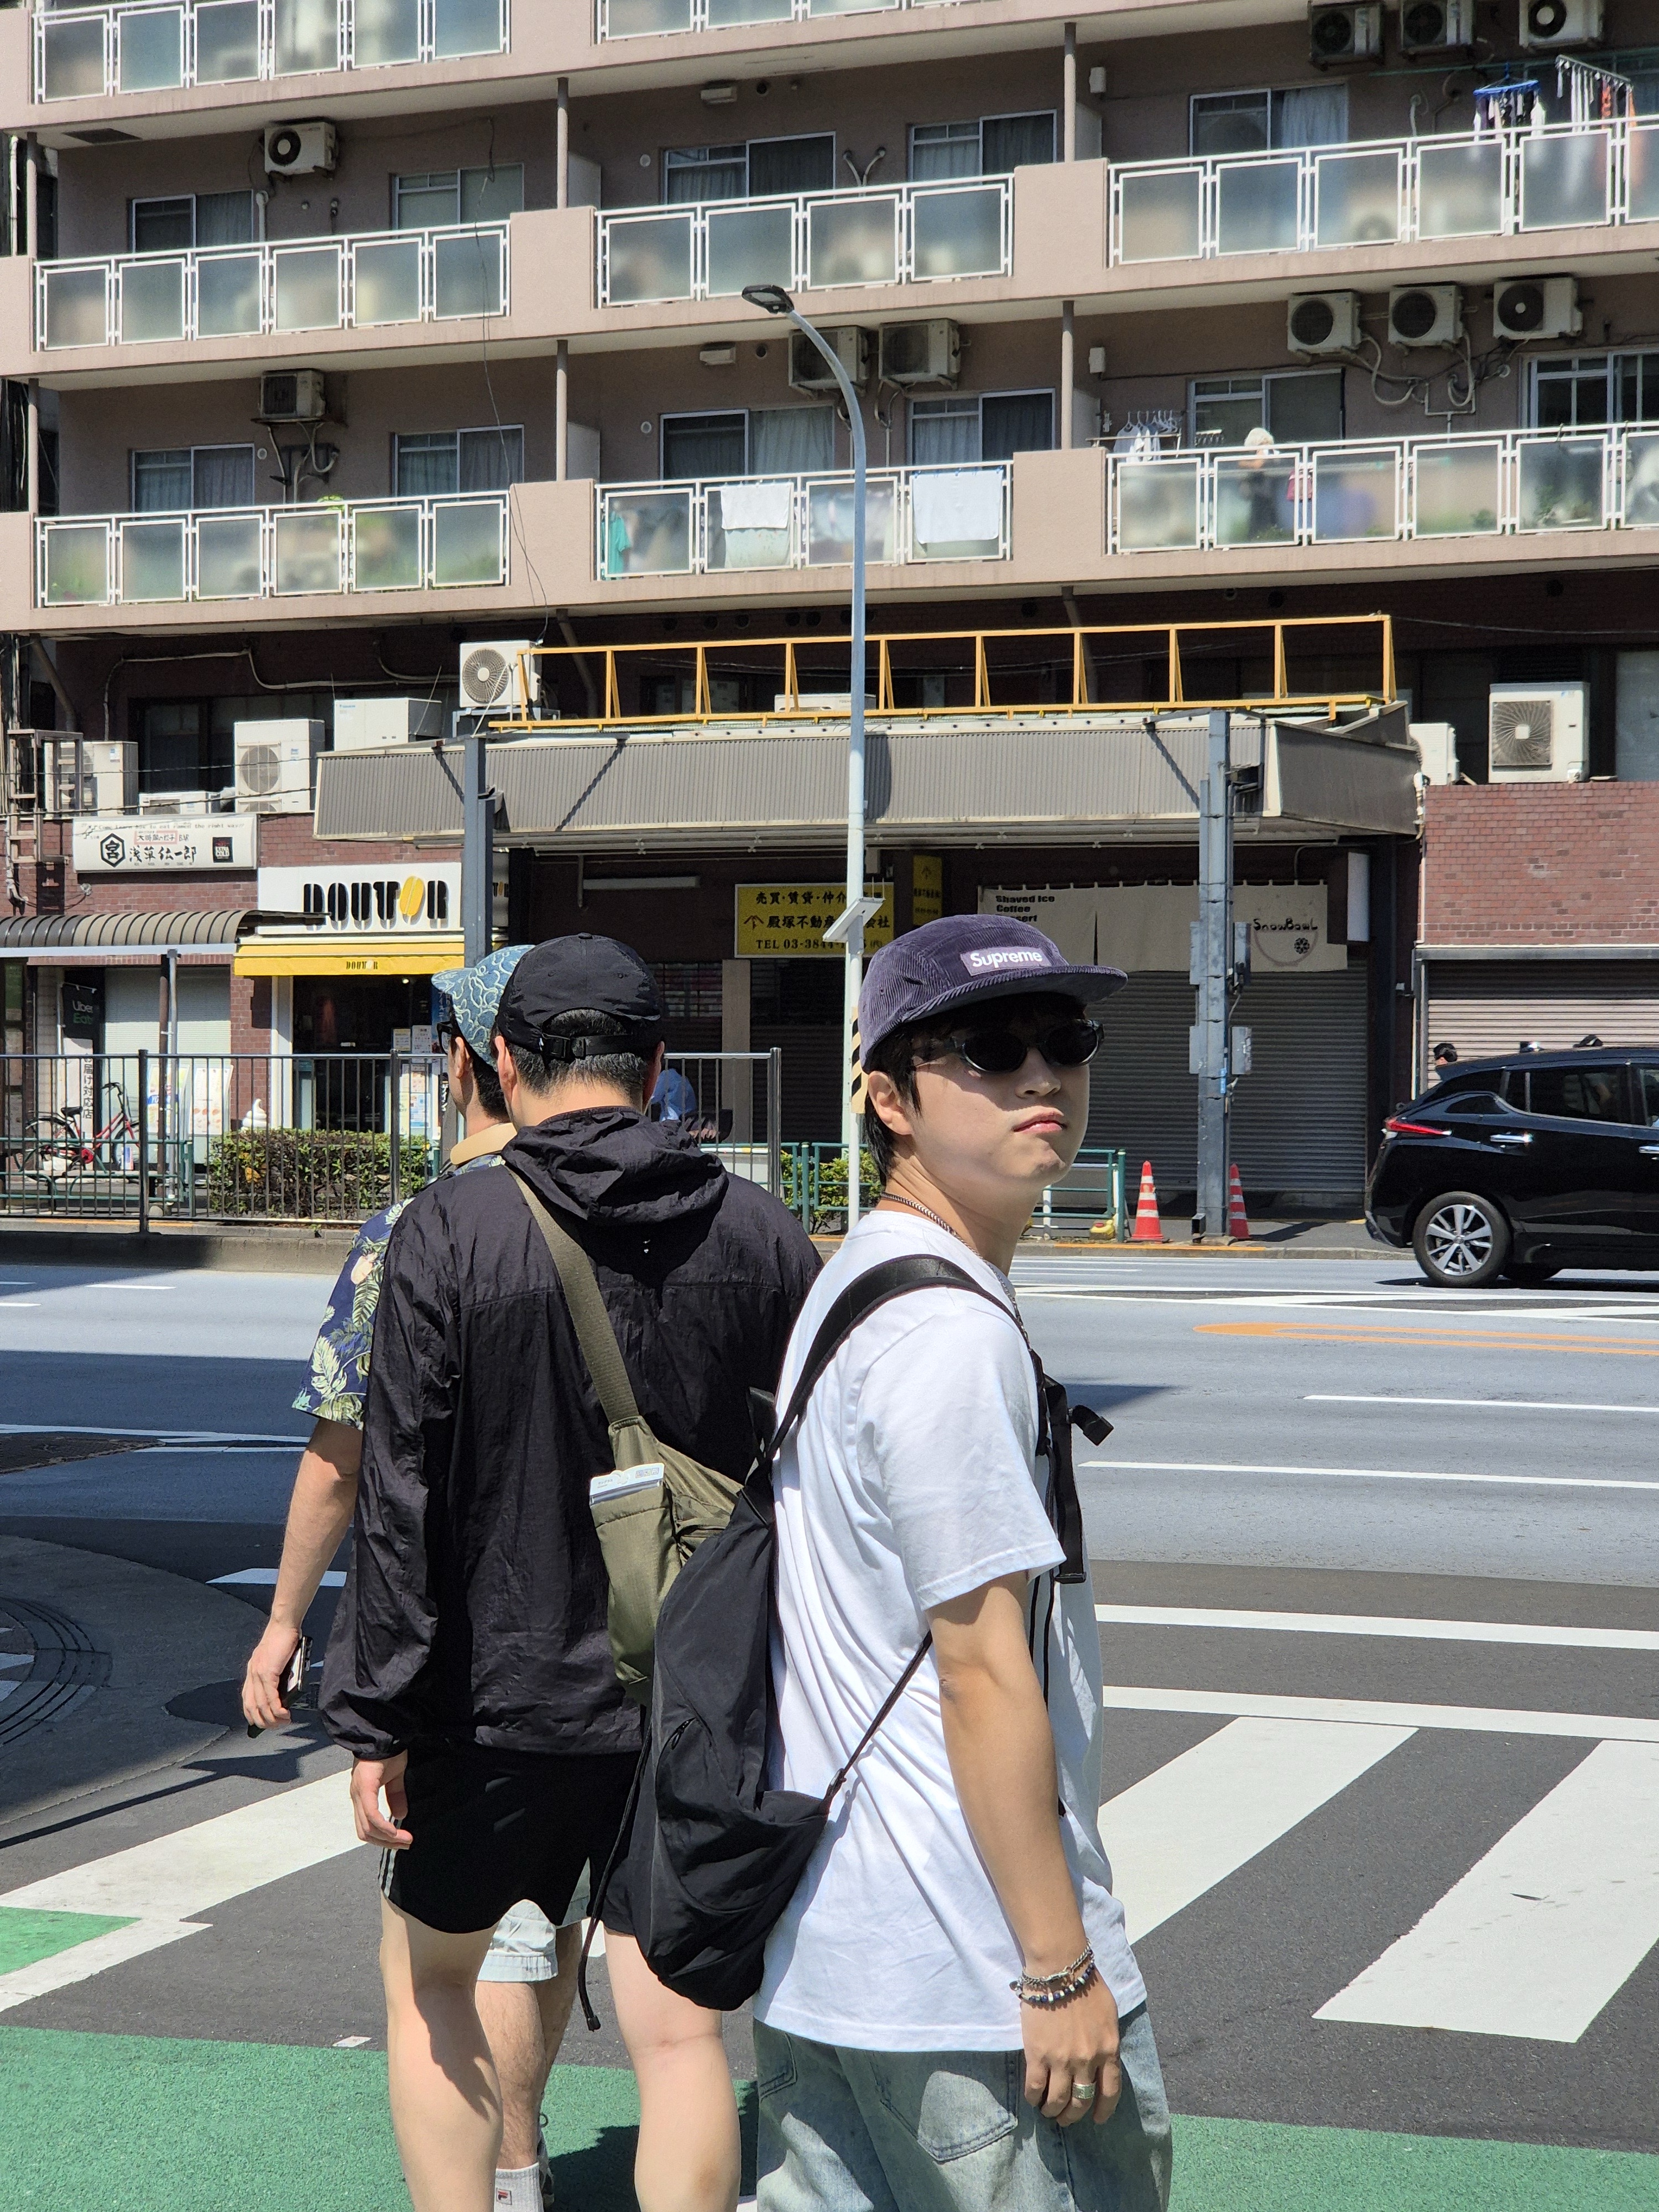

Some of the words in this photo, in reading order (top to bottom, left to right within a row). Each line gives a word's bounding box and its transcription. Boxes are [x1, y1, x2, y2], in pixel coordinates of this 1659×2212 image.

[304, 876, 449, 921] DOUTOR
[996, 904, 1031, 912] Coffee
[755, 940, 779, 949] TEL
[346, 959, 378, 970] DOUTOR
[970, 951, 1043, 968] Supreme
